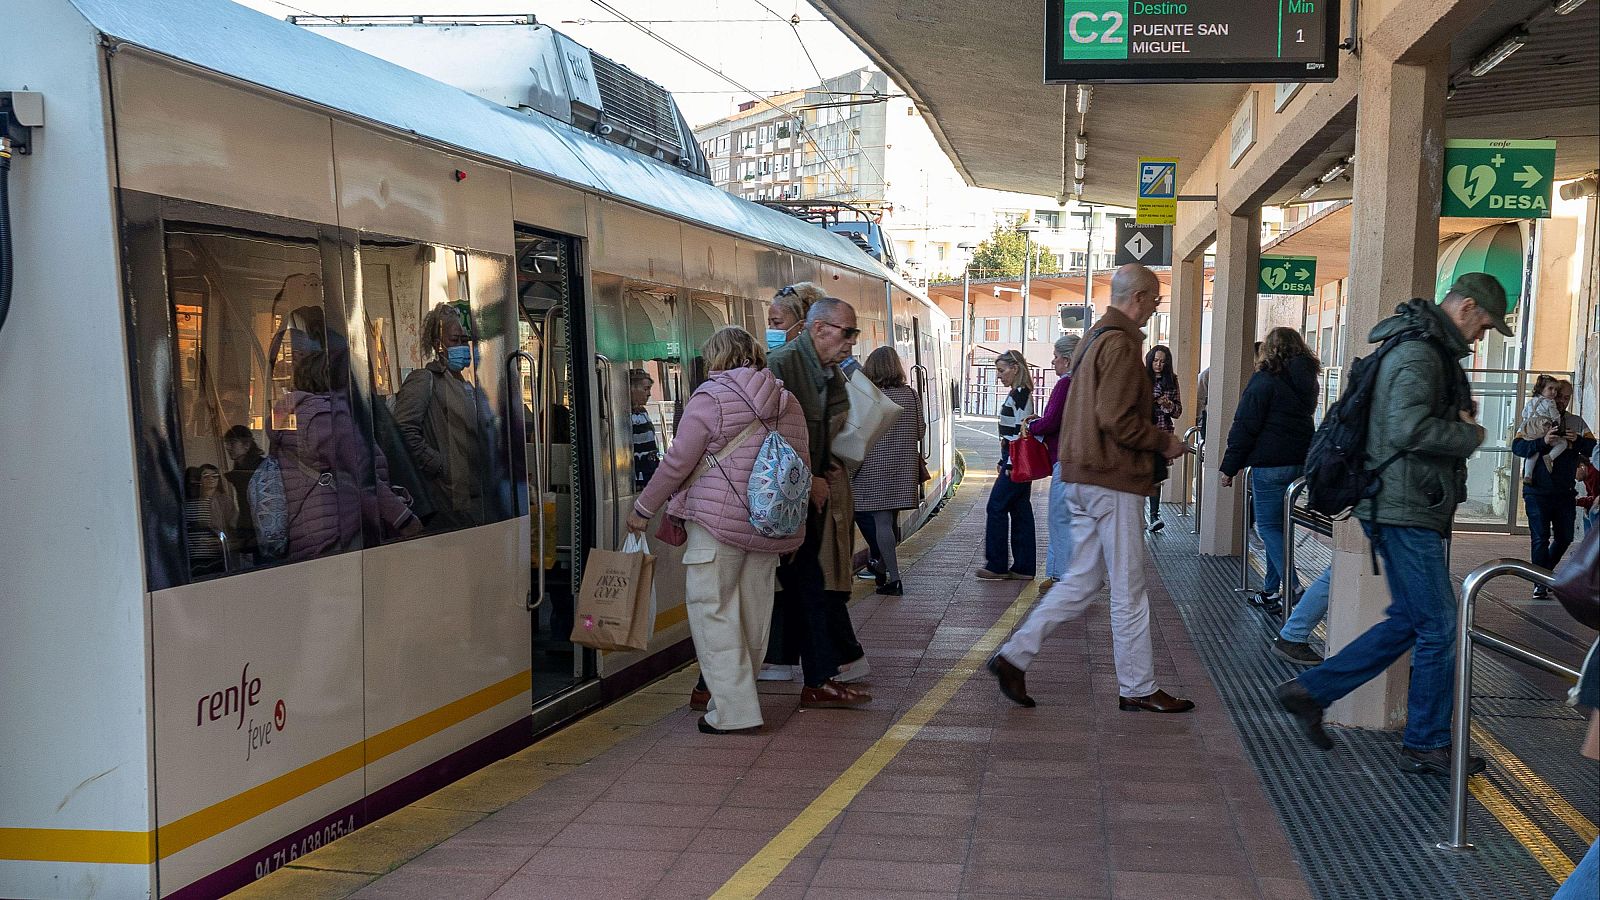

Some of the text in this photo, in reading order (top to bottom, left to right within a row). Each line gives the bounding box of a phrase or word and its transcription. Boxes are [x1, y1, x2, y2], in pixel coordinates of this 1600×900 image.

[1133, 1, 1188, 15] Destino
[1068, 10, 1124, 44] C2
[1133, 23, 1229, 36] PUENTE SAN
[1295, 29, 1305, 43] 1
[1132, 41, 1190, 53] MIGUEL
[1489, 195, 1547, 209] DESA
[1134, 238, 1142, 253] 1
[1282, 283, 1312, 291] DESA
[197, 662, 262, 730] renfe
[246, 718, 272, 761] feve
